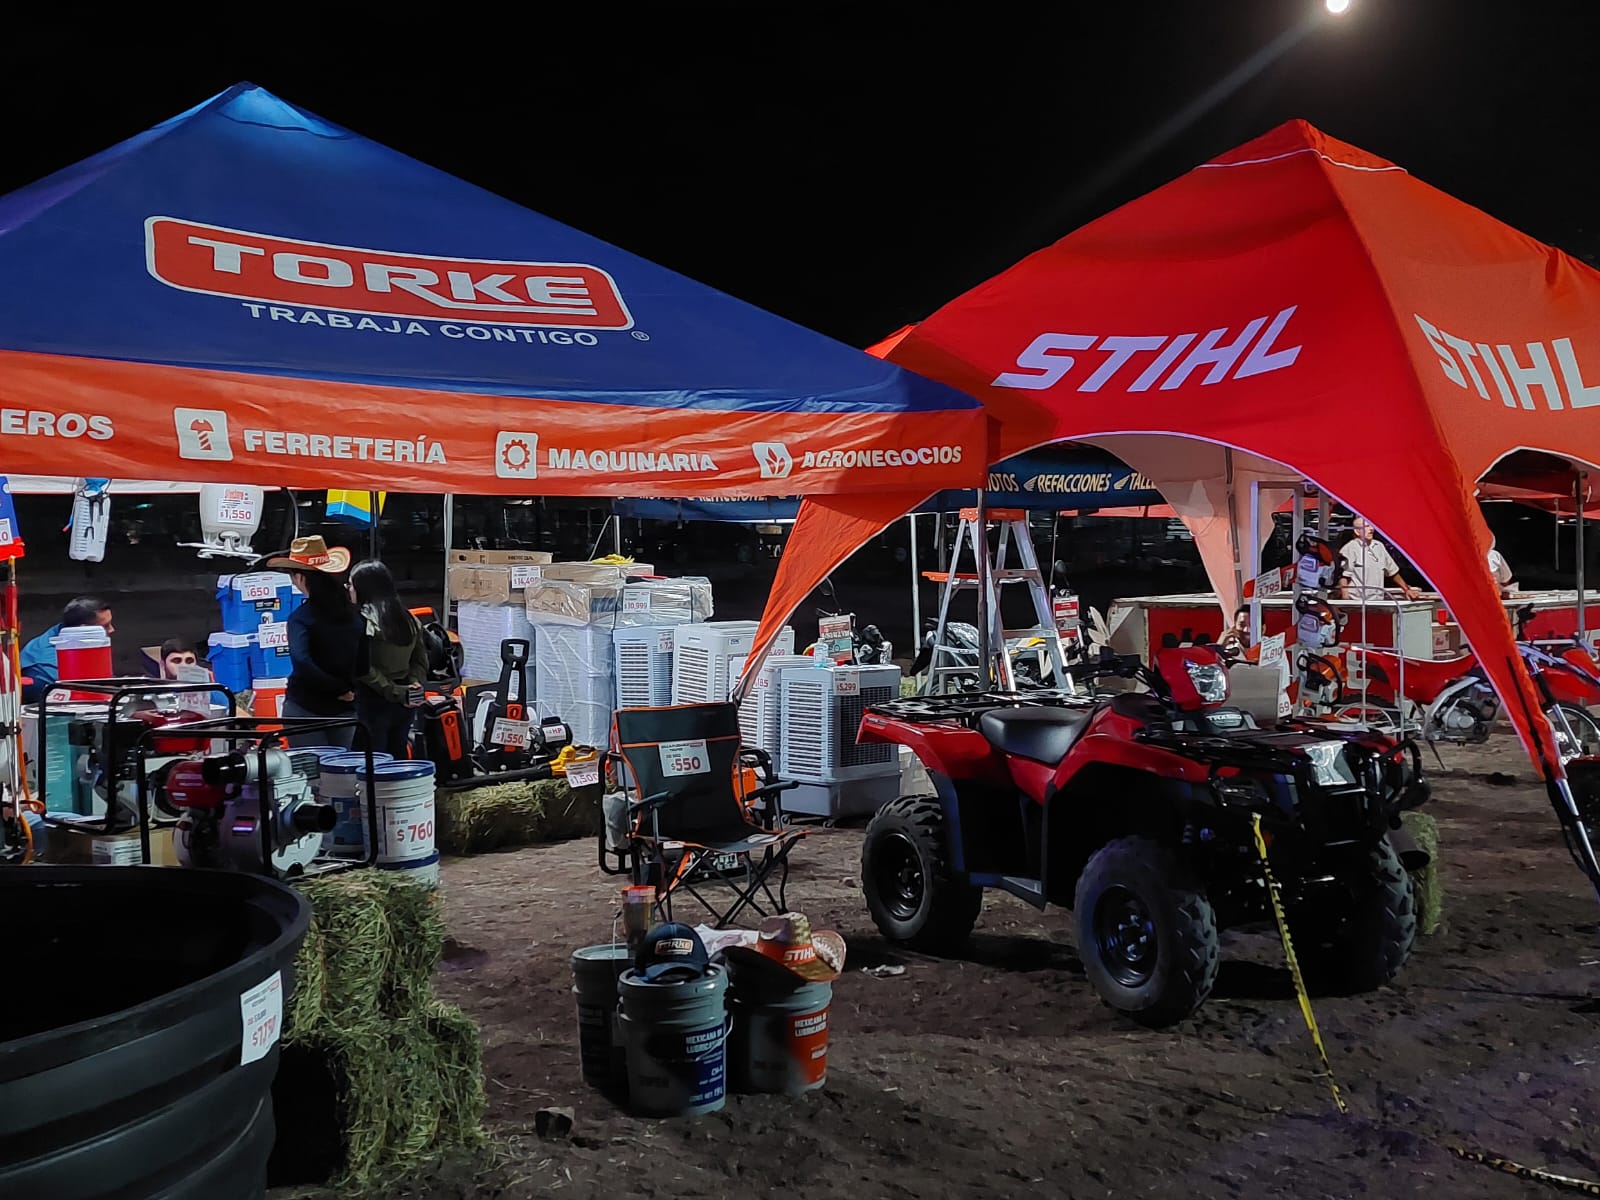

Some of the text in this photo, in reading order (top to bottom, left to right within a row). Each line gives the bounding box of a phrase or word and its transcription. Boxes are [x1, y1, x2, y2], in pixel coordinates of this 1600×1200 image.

[188, 235, 597, 316] TORKE
[242, 302, 597, 346] TRABAJA CONTIGO
[991, 304, 1303, 393] STIHL
[1413, 313, 1600, 412] STIHL
[243, 428, 447, 466] FERRETERÍA
[799, 445, 963, 468] AGRONEGOCIOS
[548, 446, 718, 473] MAQUINARIA
[986, 473, 1020, 492] OTOS
[1036, 472, 1112, 493] REFACCIONES
[220, 508, 252, 520] $1,550
[247, 586, 270, 597] $650
[495, 731, 524, 744] $1,550
[671, 756, 701, 771] $550
[784, 947, 816, 962] STIHL
